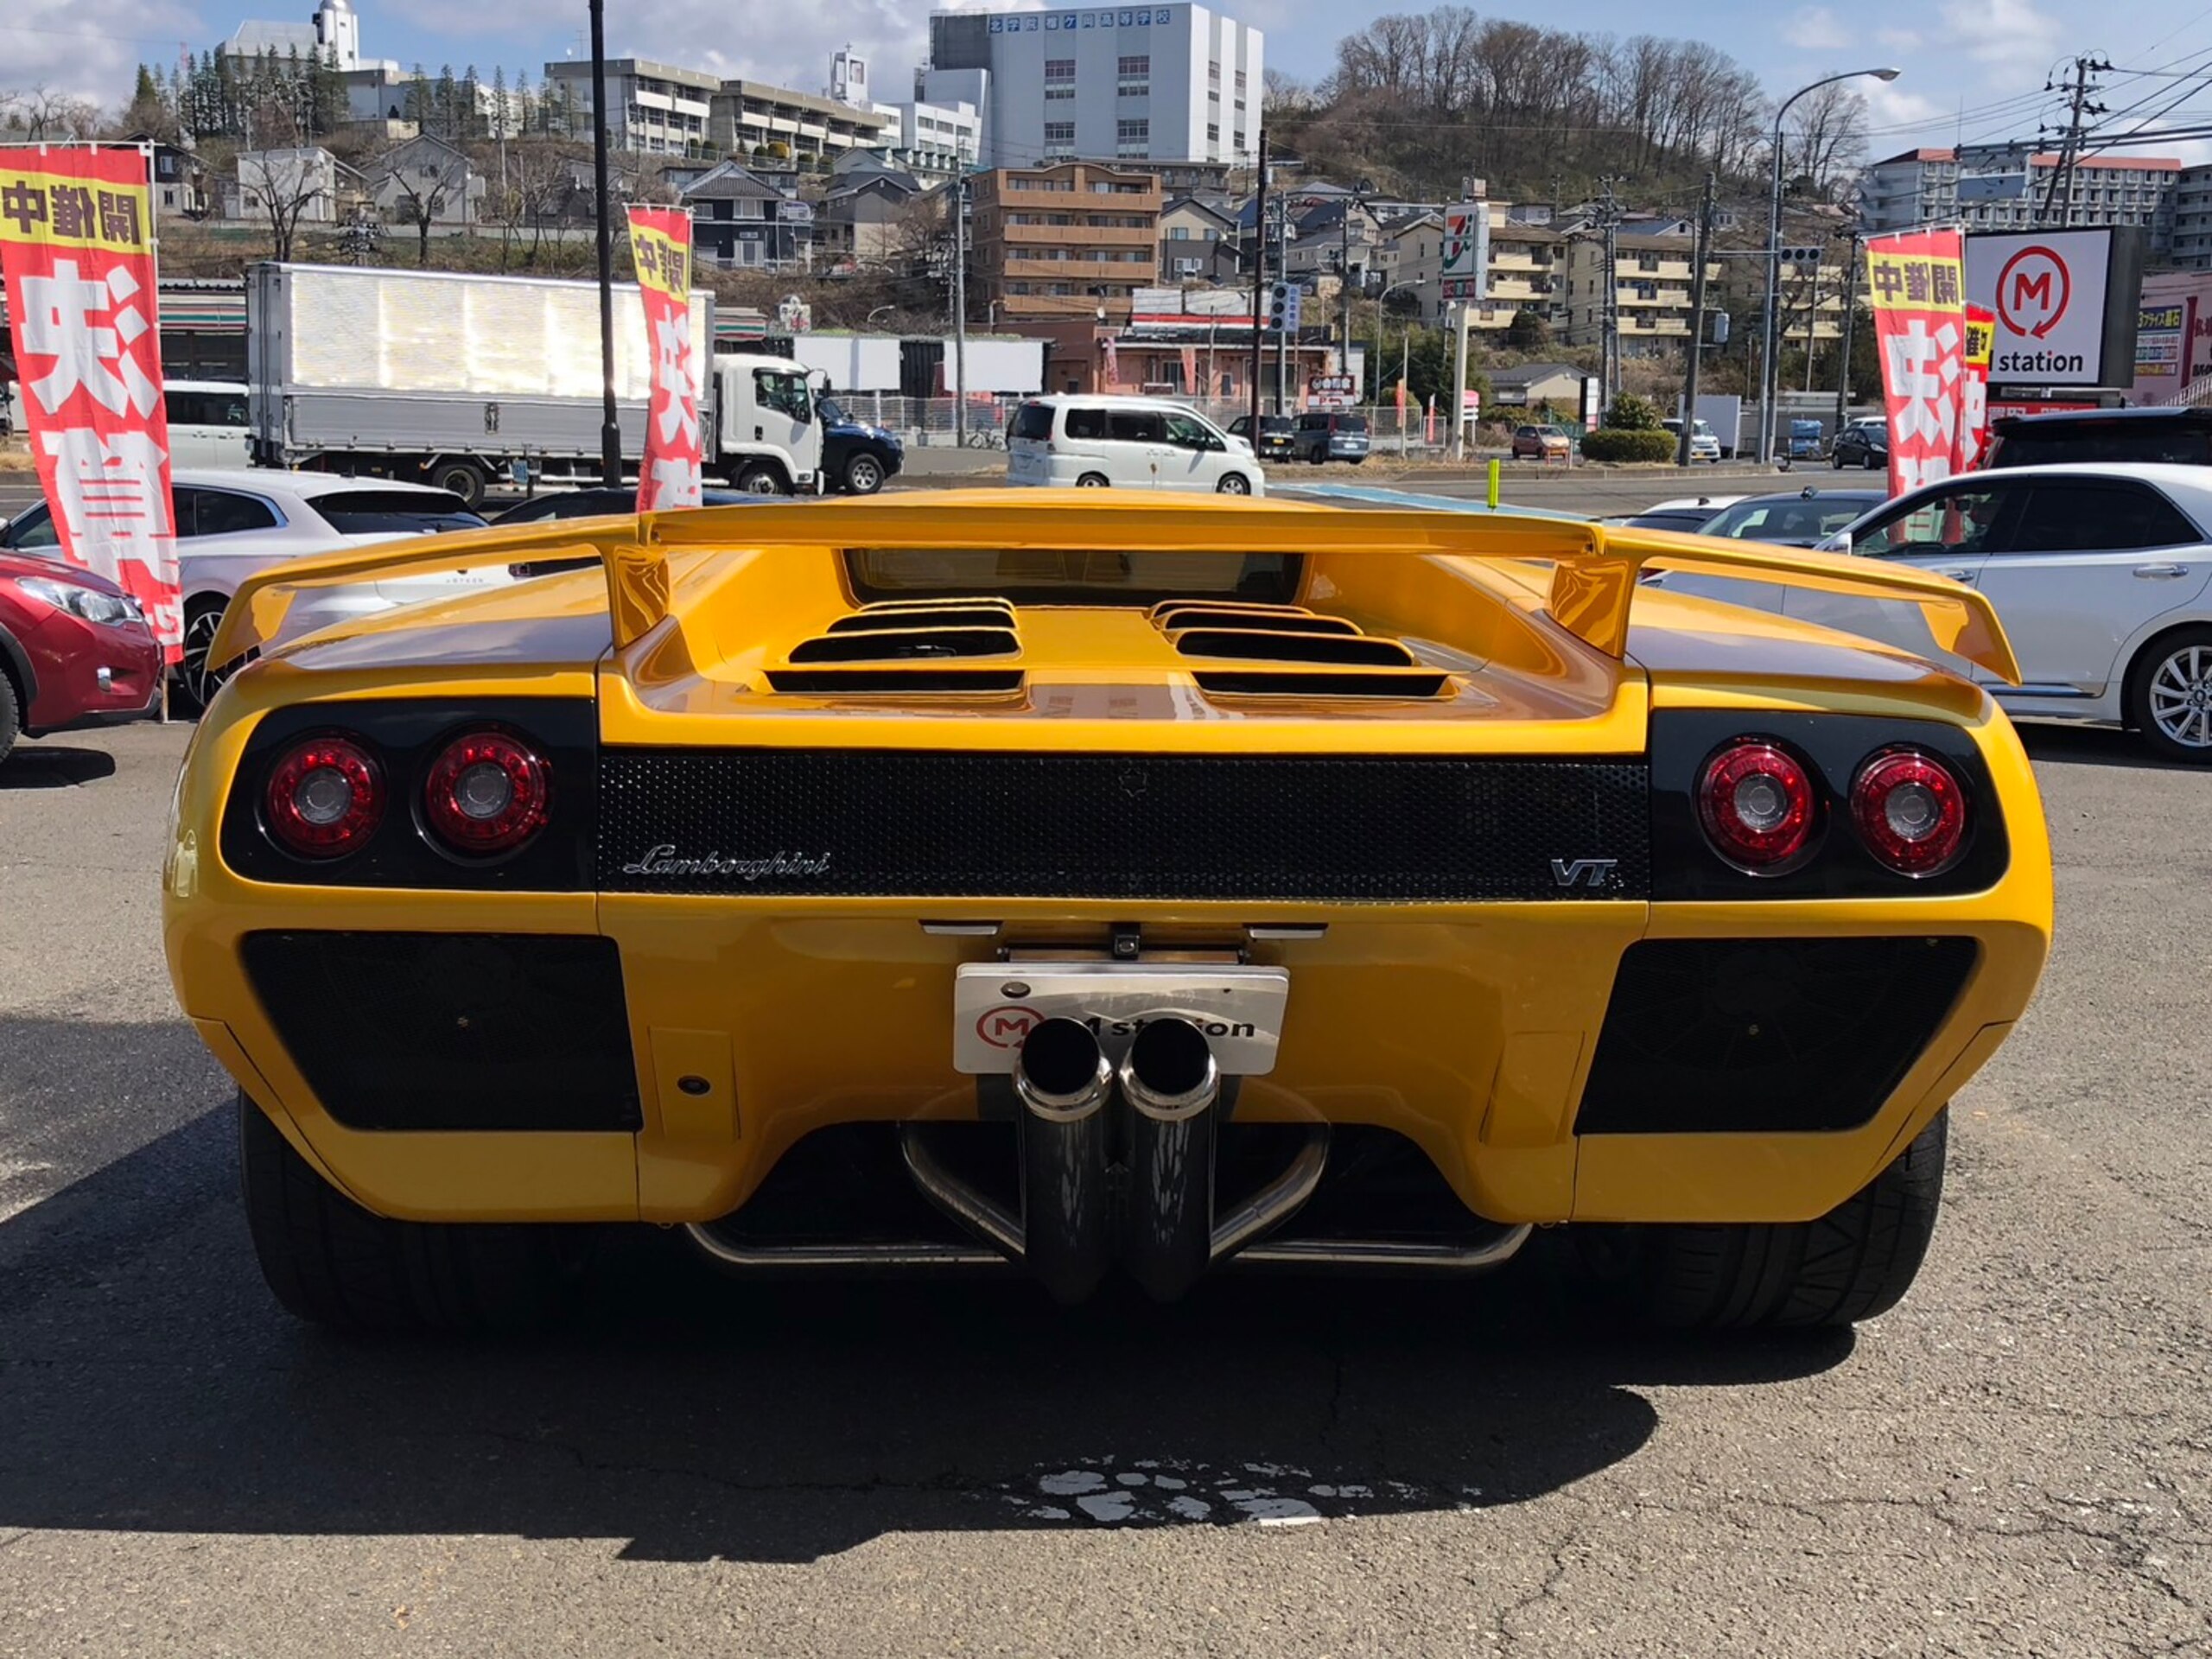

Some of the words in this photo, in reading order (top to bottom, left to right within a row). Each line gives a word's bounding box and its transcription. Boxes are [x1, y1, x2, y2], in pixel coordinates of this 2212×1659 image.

[1999, 350, 2083, 372] station
[622, 844, 830, 881] Lamborghini
[1550, 858, 1618, 887] VT
[1111, 1017, 1255, 1038] stion
